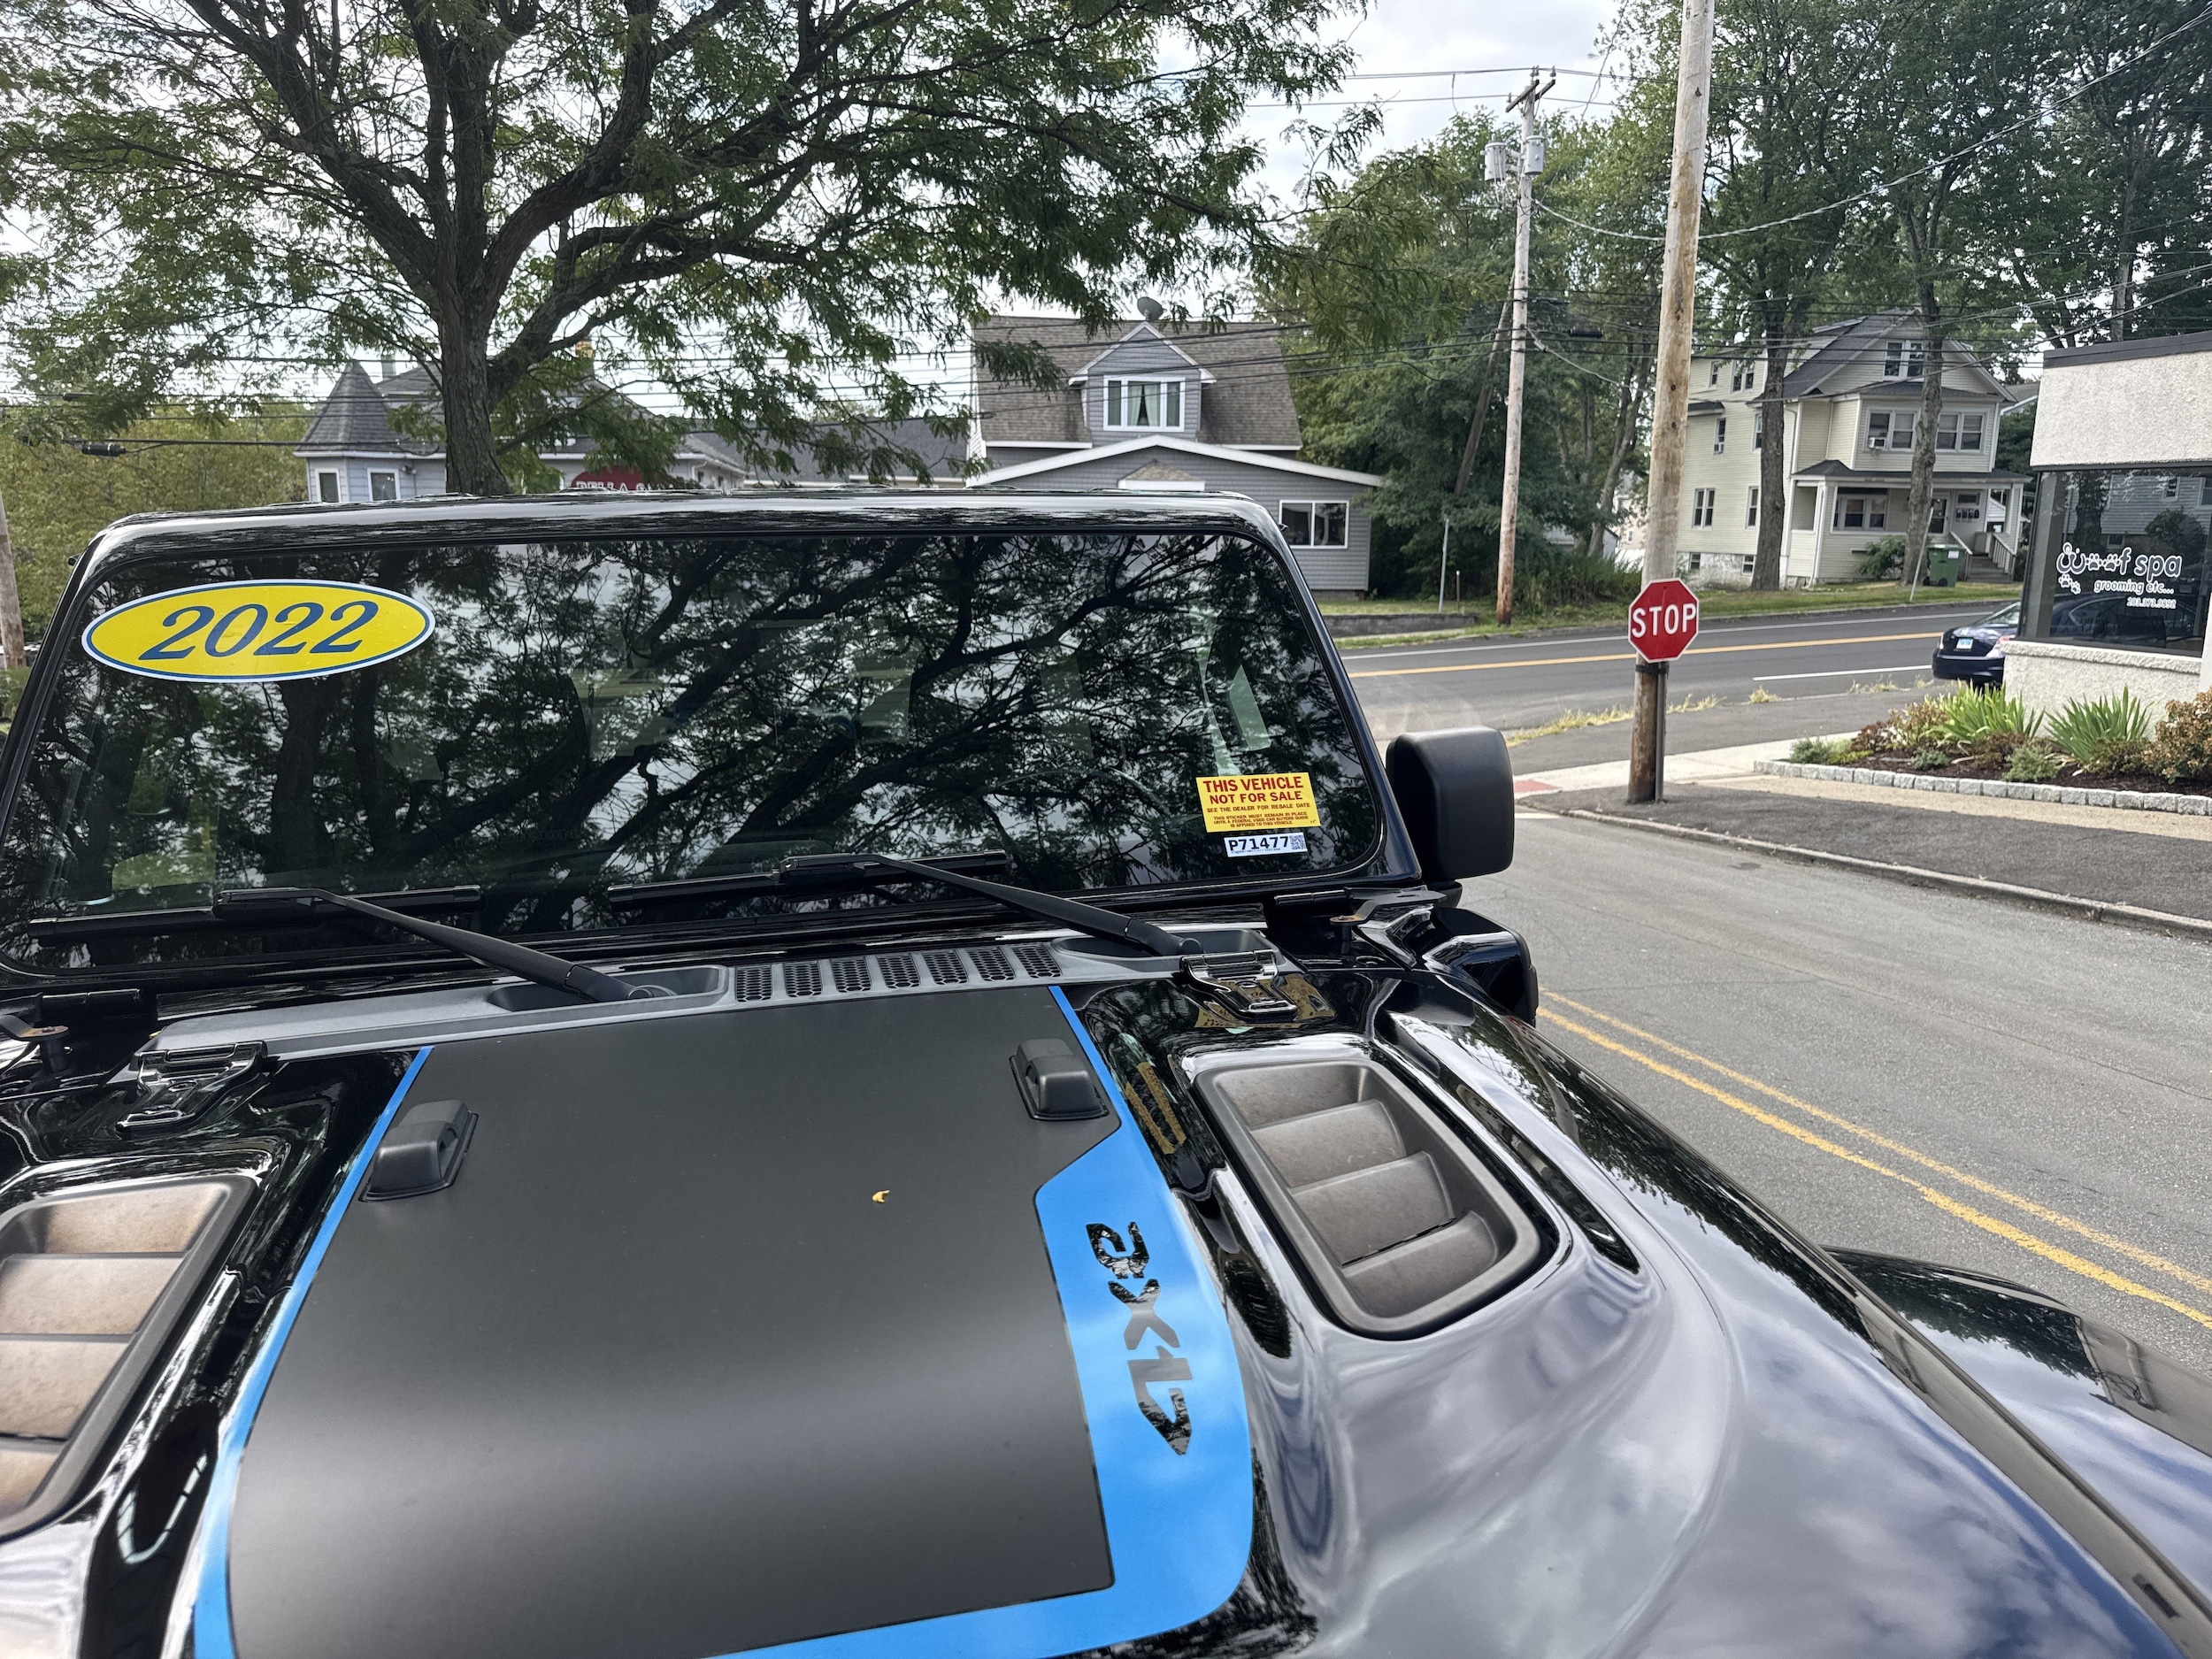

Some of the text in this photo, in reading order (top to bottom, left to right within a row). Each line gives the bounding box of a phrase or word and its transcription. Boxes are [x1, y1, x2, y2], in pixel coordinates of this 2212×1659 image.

[2134, 554, 2182, 582] spa
[2093, 579, 2144, 595] grooming
[1632, 603, 1696, 638] STOP
[138, 600, 379, 660] 2022
[1203, 776, 1303, 793] THIS VEHICLE
[1210, 791, 1302, 804] NOT FOR SALE
[1228, 836, 1289, 850] P71477
